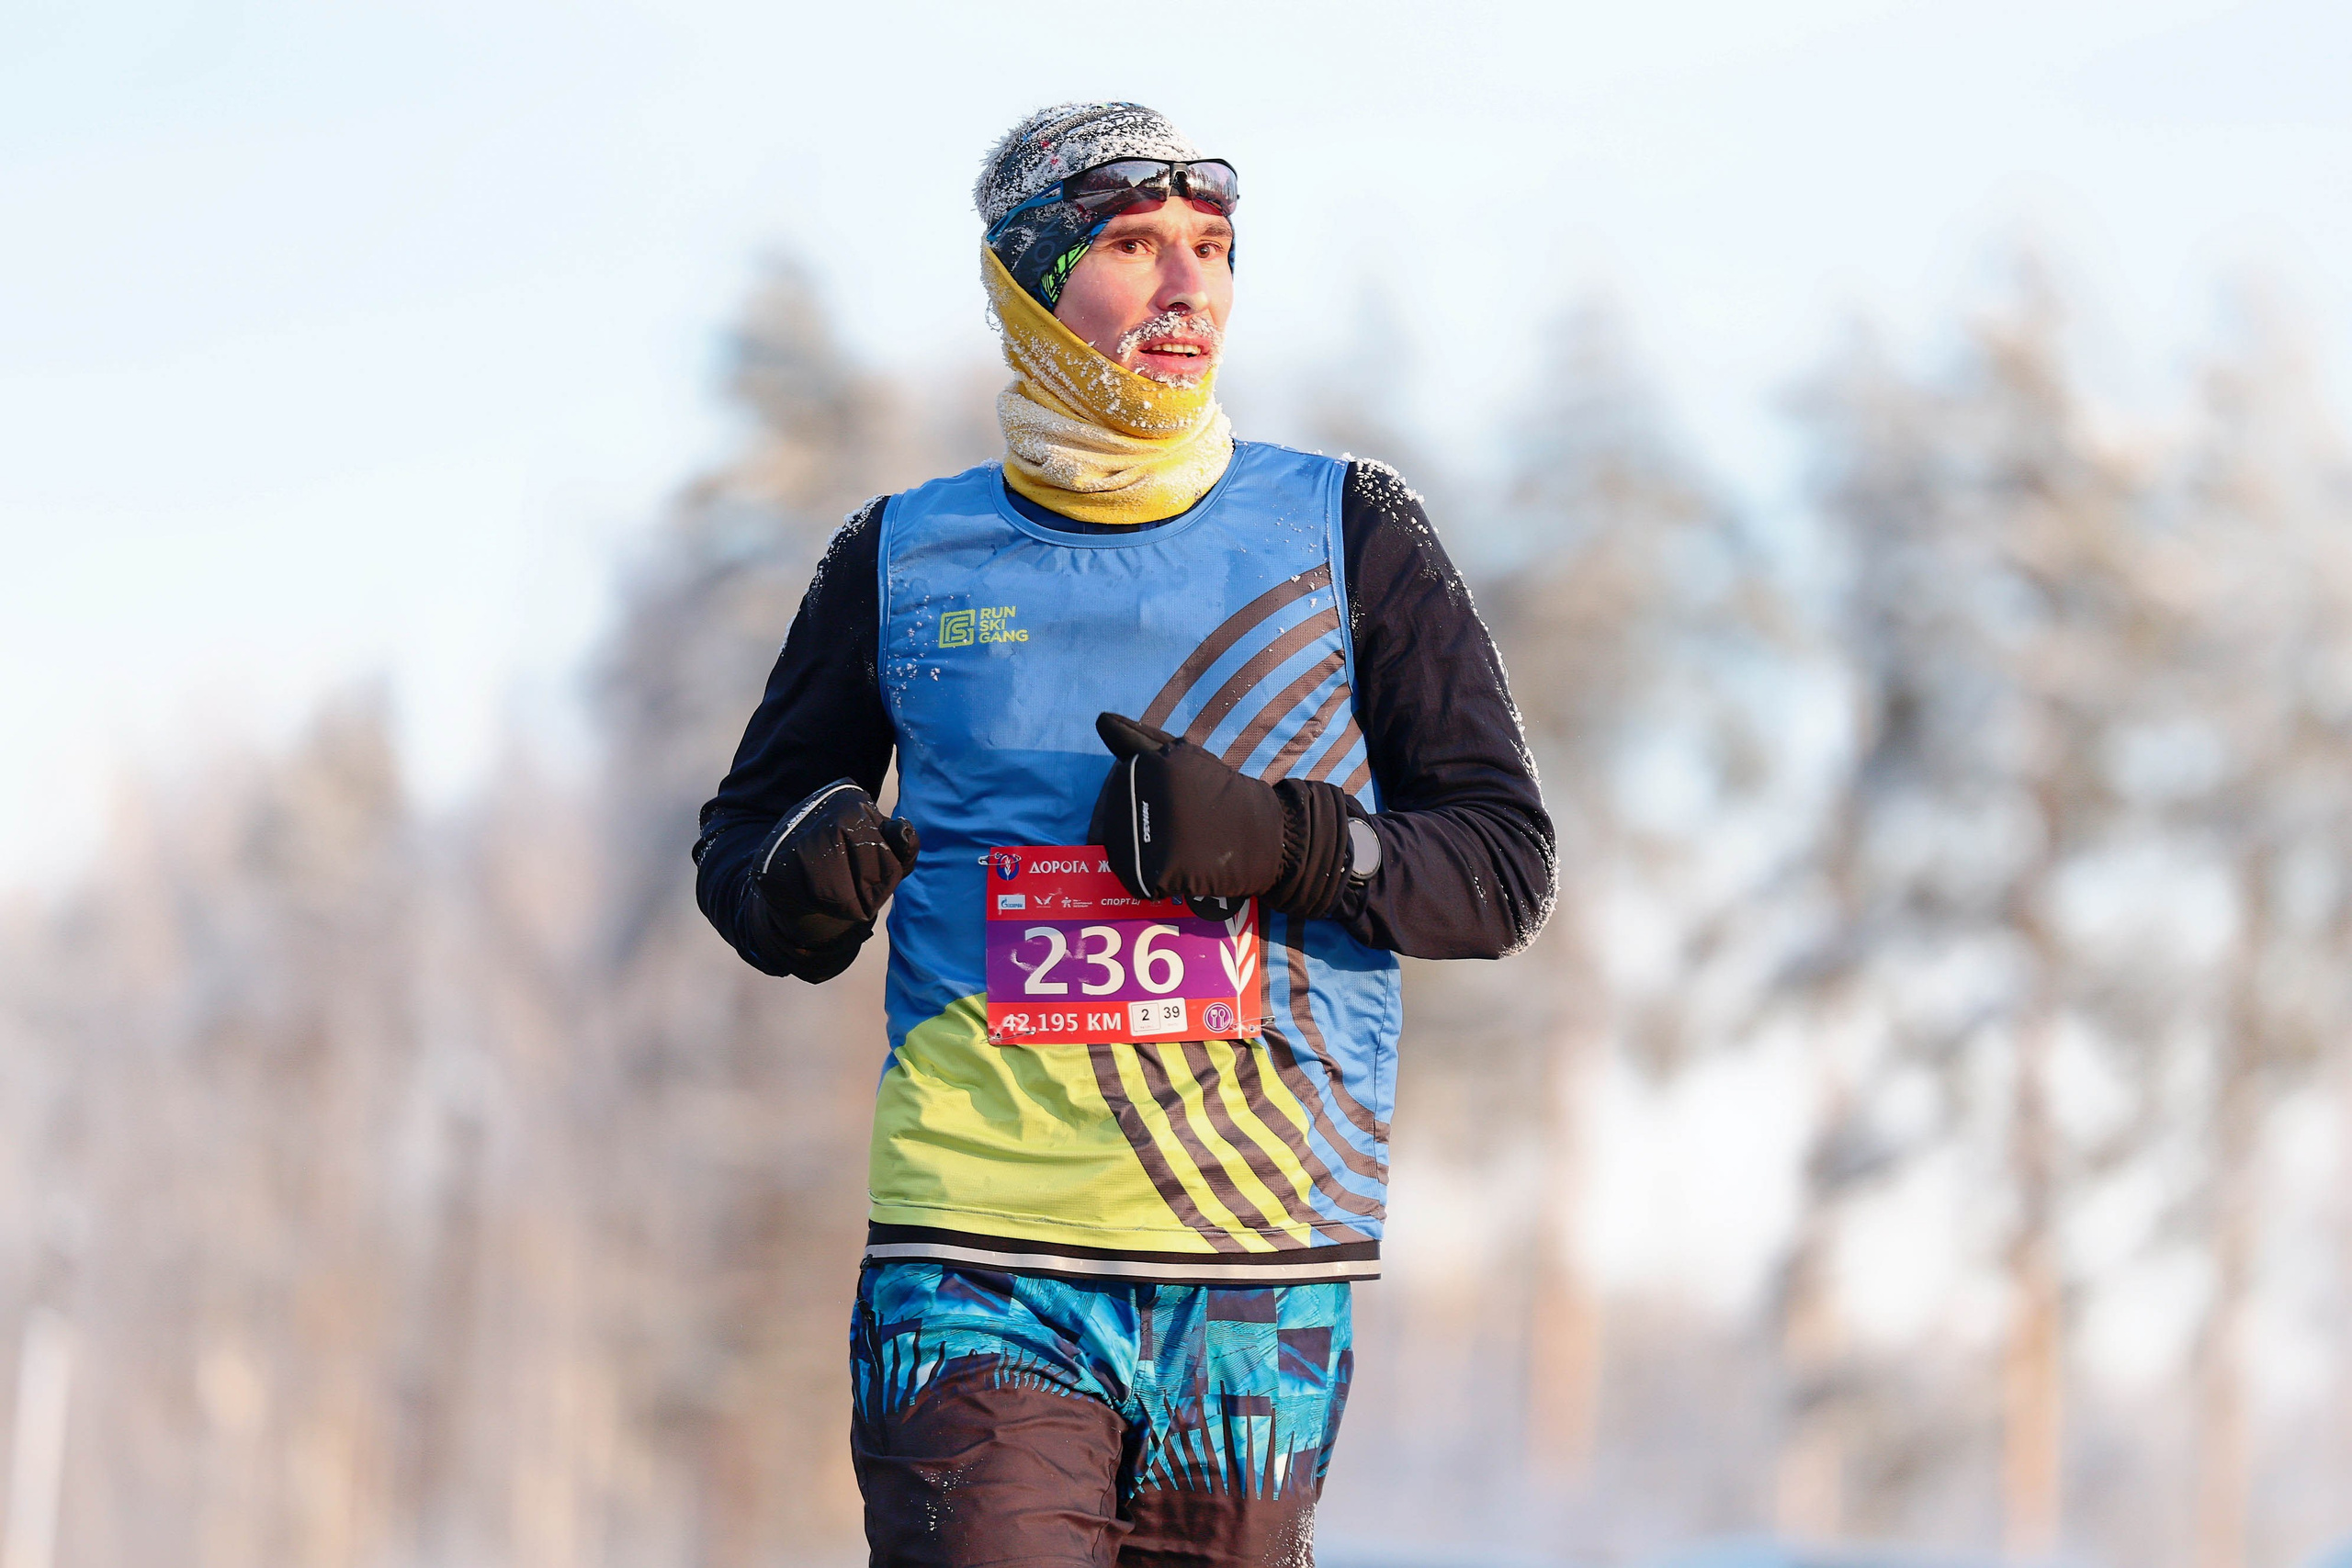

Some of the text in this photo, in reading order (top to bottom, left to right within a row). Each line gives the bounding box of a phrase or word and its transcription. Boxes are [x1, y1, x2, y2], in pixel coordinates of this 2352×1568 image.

[980, 605, 1017, 619] RUN
[979, 618, 1006, 632] SKI
[978, 629, 1029, 644] GANG
[1029, 860, 1112, 874] ДОРОГА Ж
[1024, 924, 1185, 996] 236
[1141, 1005, 1181, 1021] 2 39
[1002, 1012, 1080, 1032] 42,195
